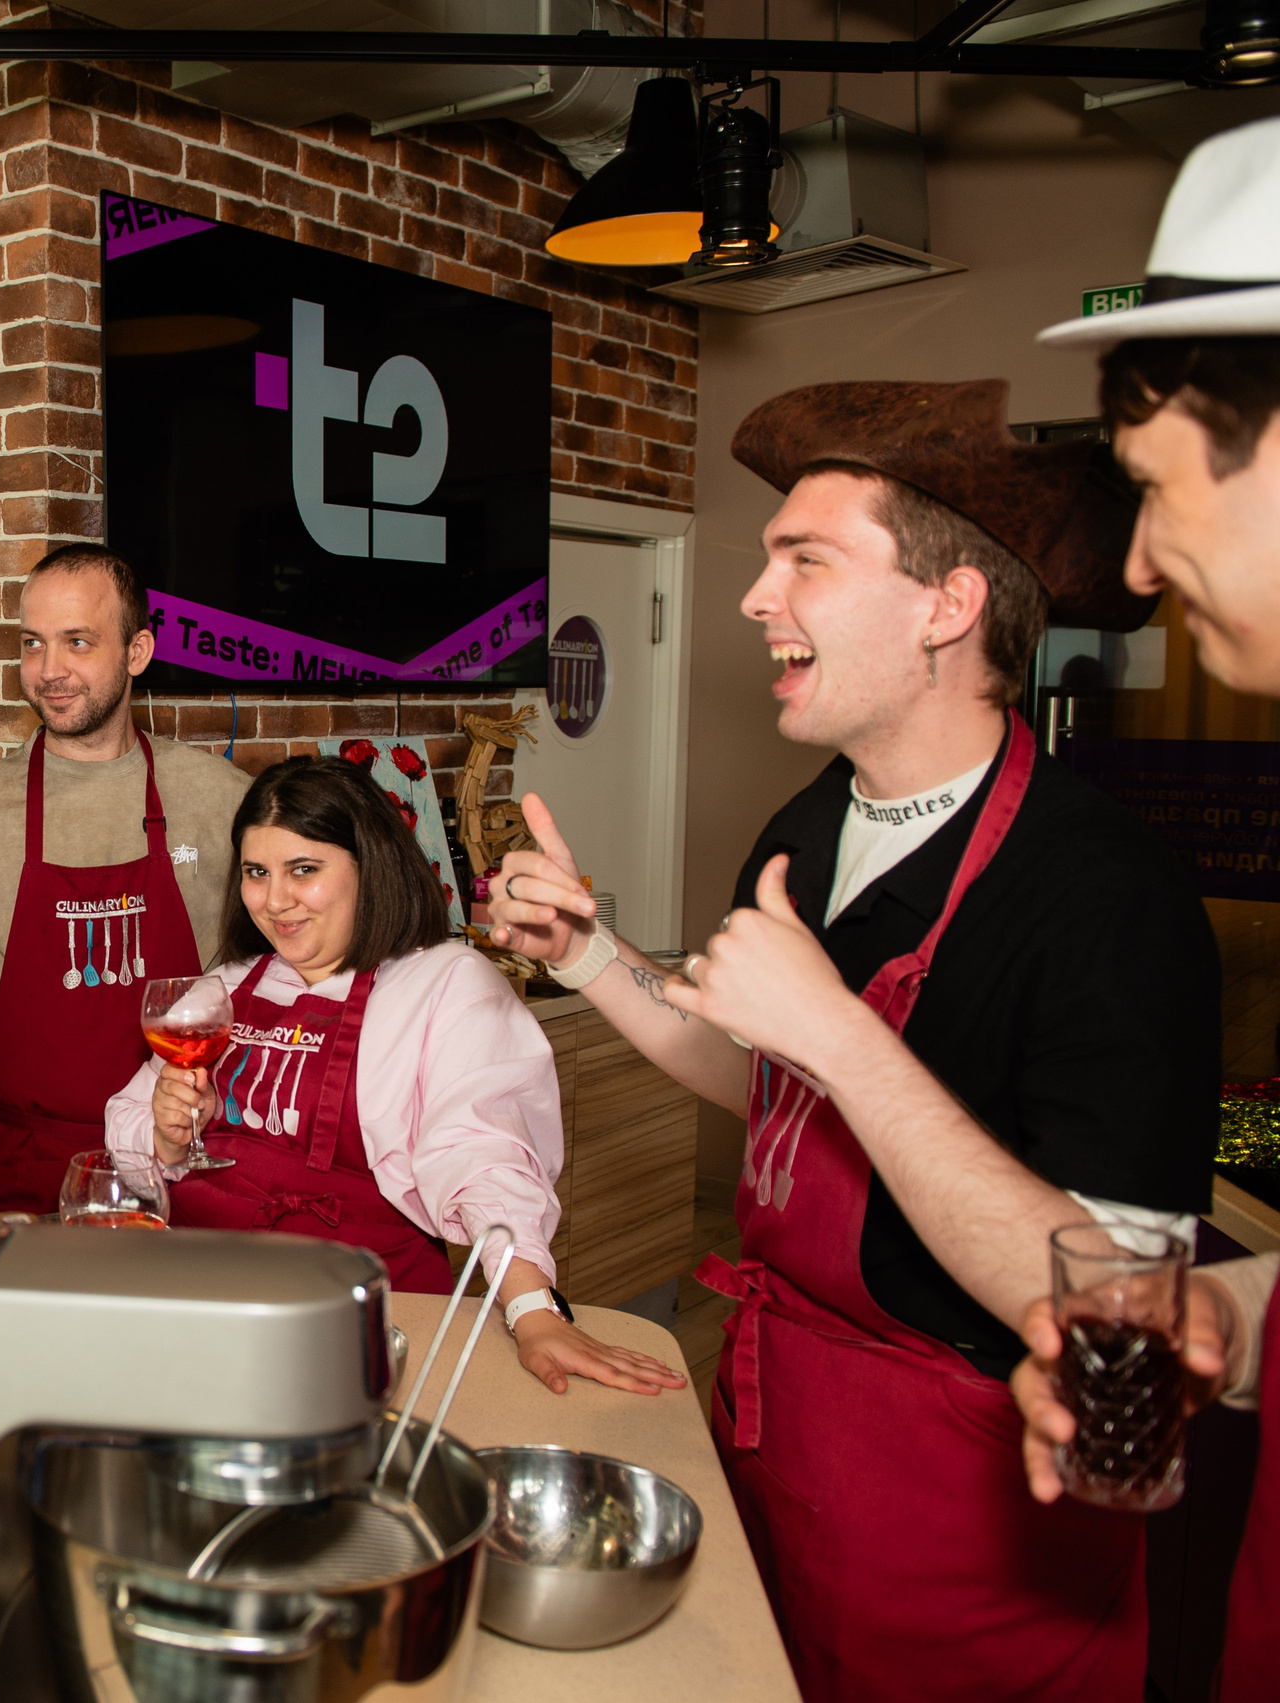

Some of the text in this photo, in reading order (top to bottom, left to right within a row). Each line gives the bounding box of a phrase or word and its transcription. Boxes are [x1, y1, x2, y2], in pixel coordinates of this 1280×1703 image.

[255, 297, 449, 564] t2
[177, 616, 279, 674] Taste:
[420, 641, 482, 680] ame
[490, 611, 512, 649] of
[862, 789, 956, 826] Angeles
